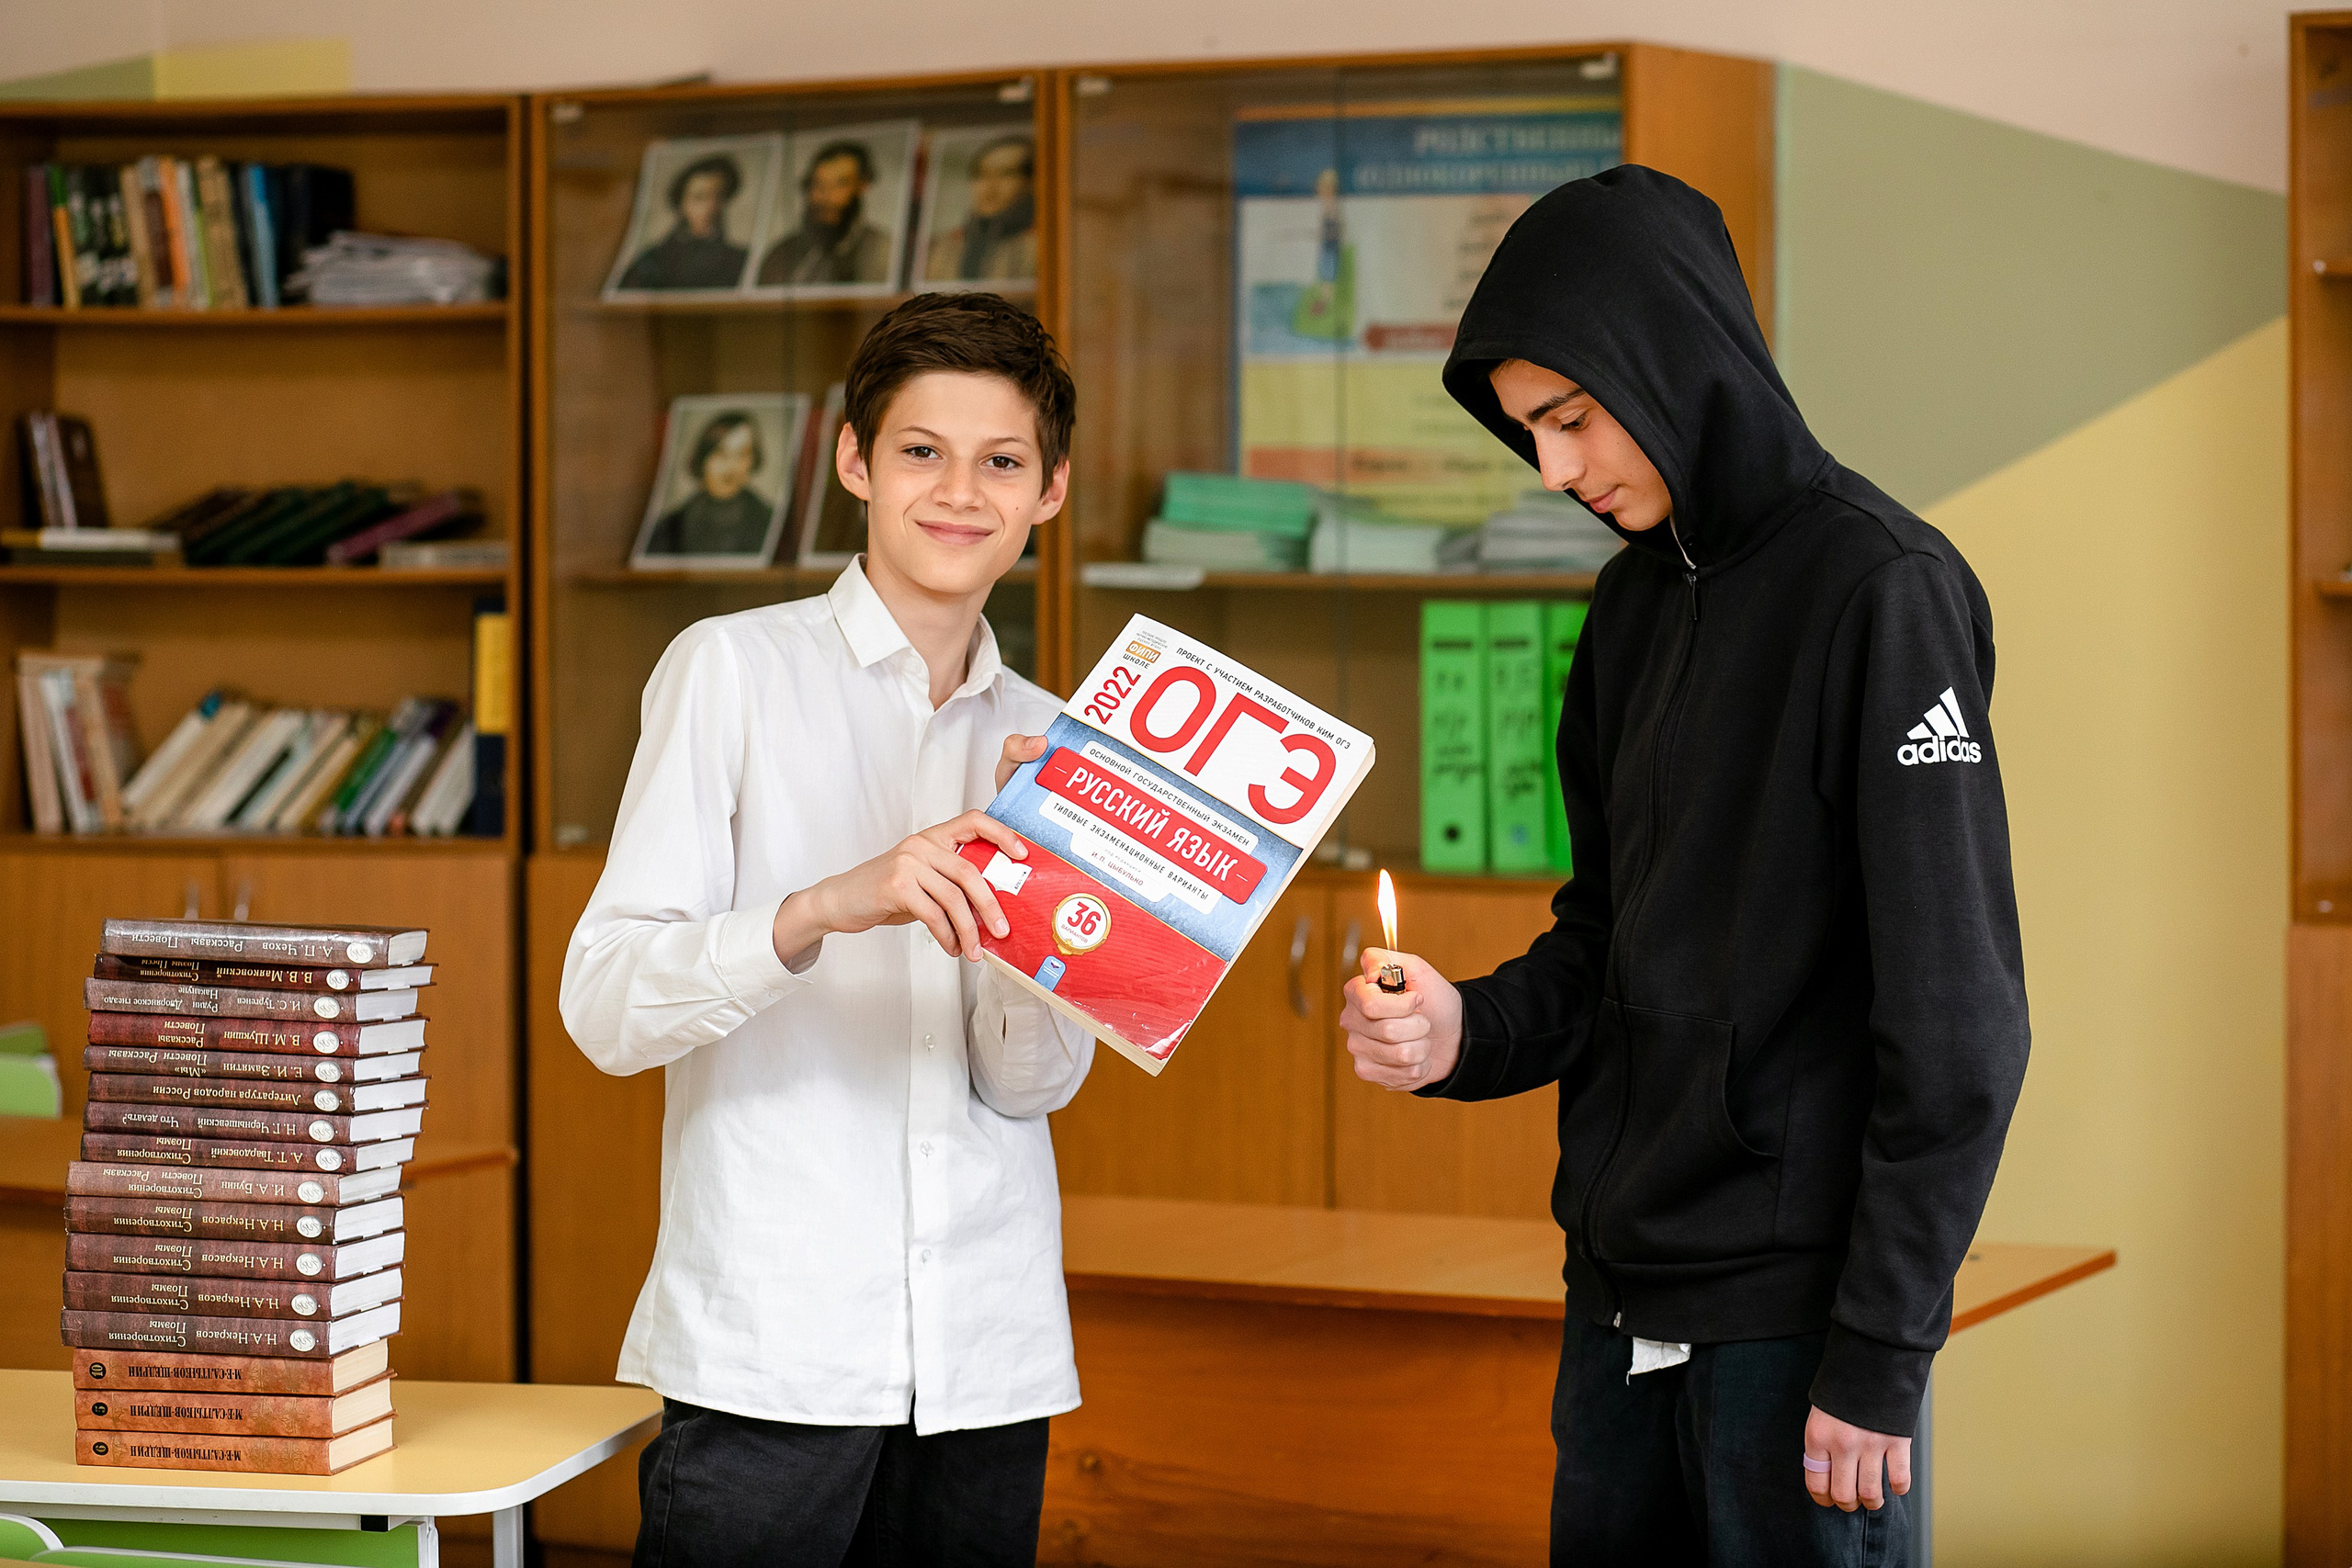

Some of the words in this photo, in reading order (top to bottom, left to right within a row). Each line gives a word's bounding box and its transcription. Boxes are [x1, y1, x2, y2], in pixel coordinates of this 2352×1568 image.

[1128, 641, 1159, 662] ФИПИ
[1123, 653, 1150, 670] ШКОЛЕ
[1084, 666, 1141, 725] 2022
[1176, 647, 1205, 667] ПРОЕКТ
[1205, 662, 1214, 671] С
[1214, 667, 1253, 693] УЧАСТИЕМ
[1253, 690, 1316, 729] РАЗРАБОТЧИКОВ
[1317, 726, 1335, 740] КИМ
[1335, 737, 1351, 750] ОГЭ
[1130, 666, 1337, 824] ОГЭ
[1896, 735, 1983, 766] adidas
[1090, 749, 1132, 775] ОСНОВНОЙ
[1133, 773, 1210, 822] ГОСУДАРСТВЕННЫЙ
[1211, 819, 1250, 846] ЭКЗАМЕН
[1066, 766, 1170, 840] РУССКИЙ
[1165, 827, 1238, 882] ЯЗЫК
[1053, 803, 1089, 827] ТИПОВЫЕ
[1091, 824, 1166, 874] ЭКЗАМЕНАЦИОННЫЕ
[1168, 871, 1209, 900] ВАРИАНТЫ
[1107, 861, 1144, 886] ЦЫБУЛЬКО
[1068, 901, 1102, 935] 36
[131, 934, 178, 948] Повести
[1060, 924, 1089, 943] ВАРИАНТОВ
[190, 937, 243, 952] Рассказы
[262, 942, 298, 955] Чехов
[141, 959, 167, 969] Пьесы
[172, 961, 199, 971] Поэмы
[140, 969, 199, 982] Стихотворения
[216, 967, 283, 982] Маяковский
[178, 987, 218, 999] Накануне
[104, 997, 131, 1006] гнездо
[133, 998, 183, 1010] Дворянское
[192, 1001, 218, 1012] Рудин
[237, 998, 276, 1010] Тургенев
[164, 1021, 205, 1034] Повести
[158, 1034, 204, 1048] Рассказы
[223, 1030, 268, 1045] Шукшин
[108, 1049, 158, 1064] Рассказы
[164, 1052, 207, 1066] Повести
[175, 1066, 207, 1077] «Мы»
[223, 1063, 270, 1077] Замятин
[153, 1086, 191, 1100] России
[193, 1087, 236, 1099] народов
[239, 1089, 301, 1106] Литература
[122, 1113, 158, 1124] делать?
[160, 1115, 179, 1128] Что
[198, 1117, 269, 1134] Чернышевский
[156, 1137, 191, 1150] Поэмы
[117, 1148, 191, 1165] Стихотворения
[210, 1147, 274, 1163] Твардовский
[103, 1168, 149, 1181] Рассказы
[161, 1171, 203, 1185] Повести
[128, 1183, 203, 1199] Стихотворения
[221, 1180, 253, 1194] Бунин
[155, 1206, 192, 1219] Поэмы
[113, 1216, 192, 1233] Стихотворения
[202, 1214, 254, 1230] Некрасов
[154, 1244, 192, 1258] Поэмы
[113, 1255, 191, 1271] Стихотворения
[201, 1253, 254, 1268] Некрасов
[151, 1283, 187, 1297] Поэмы
[111, 1295, 188, 1311] Стихотворения
[198, 1293, 250, 1308] Некрасов
[149, 1320, 187, 1334] Поэмы
[108, 1332, 187, 1347] Стихотворения
[196, 1329, 248, 1344] Некрасов
[90, 1362, 104, 1377] 10
[94, 1404, 107, 1414] 5
